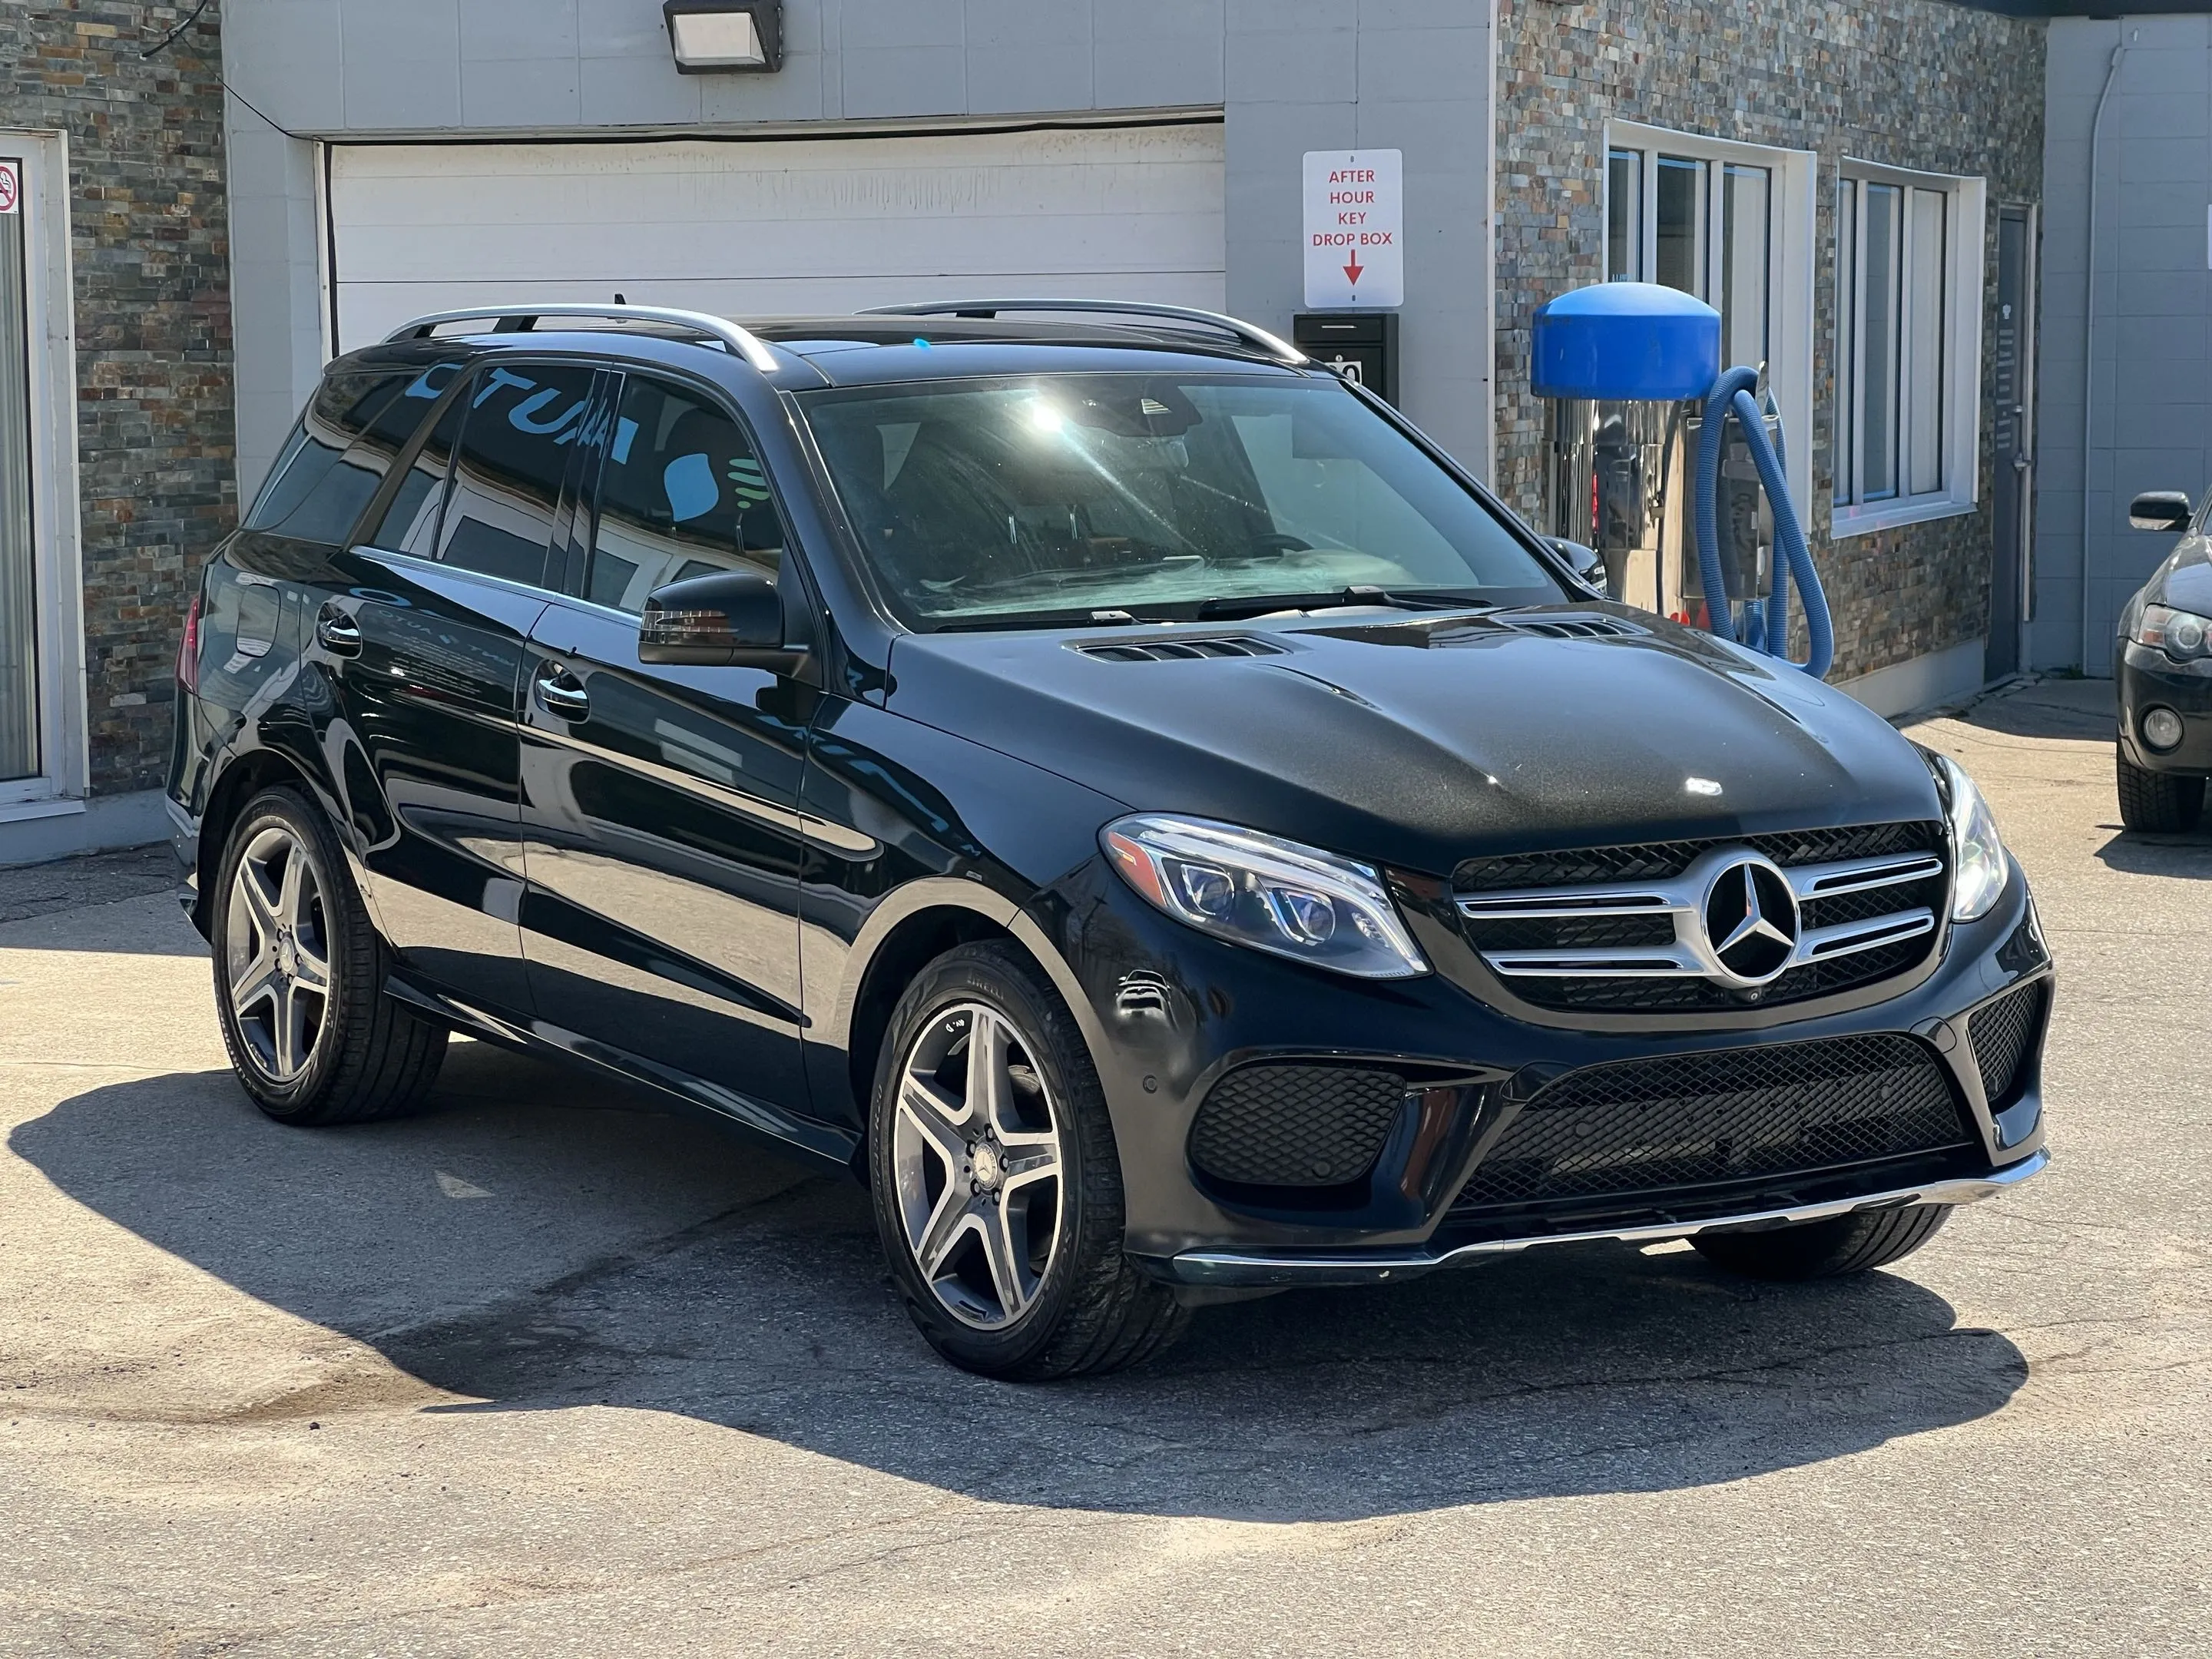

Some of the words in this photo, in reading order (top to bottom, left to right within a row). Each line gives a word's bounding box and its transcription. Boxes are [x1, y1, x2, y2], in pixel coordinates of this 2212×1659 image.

[1329, 170, 1375, 184] AFTER
[1330, 190, 1374, 204] HOUR
[1338, 212, 1366, 225] KEY
[1313, 233, 1356, 247] DROP
[1360, 232, 1392, 245] BOX
